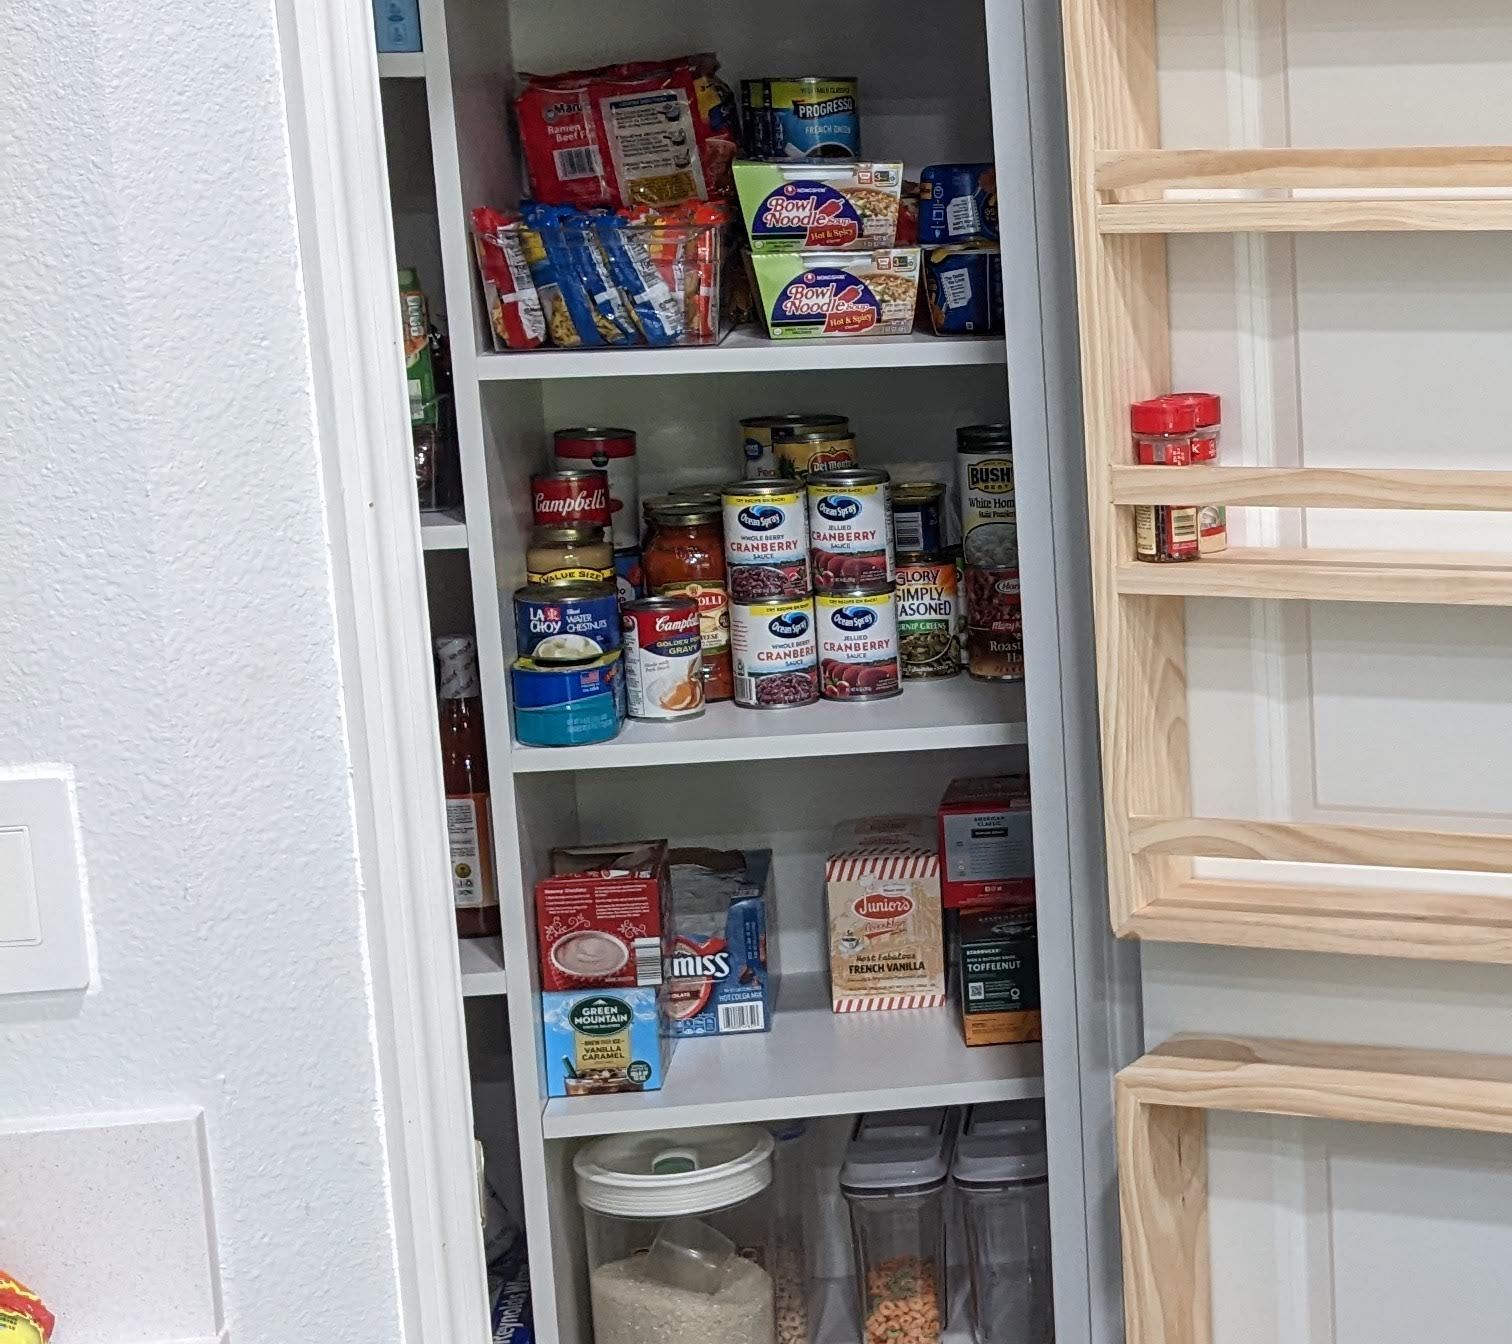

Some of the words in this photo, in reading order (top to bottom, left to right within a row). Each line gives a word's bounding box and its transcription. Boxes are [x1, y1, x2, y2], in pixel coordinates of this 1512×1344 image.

[799, 98, 853, 118] PROGRESSO
[547, 124, 581, 136] Ramen
[805, 125, 832, 135] FRENCH
[556, 132, 577, 144] Beef
[767, 196, 817, 213] Bowl
[763, 210, 828, 228] Noodle
[827, 218, 851, 227] Soup
[810, 231, 826, 241] Hot
[833, 227, 854, 239] Spicy
[787, 282, 836, 301] Bowl
[783, 298, 846, 316] Noodle
[846, 304, 870, 312] Soup
[830, 318, 844, 328] Hot
[852, 313, 873, 324] Spicy
[534, 489, 607, 516] Campbell's
[968, 497, 992, 509] White
[819, 502, 839, 517] Ocean
[837, 502, 857, 519] Spray
[740, 513, 761, 527] Ocean
[759, 513, 781, 529] Spray
[812, 529, 876, 542] CRANBERRY
[730, 540, 798, 553] CRANBERRY
[542, 571, 575, 584] VALUE
[578, 570, 603, 581] SIZE
[895, 569, 941, 586] GLORY
[529, 607, 545, 621] LA
[566, 613, 593, 623] WATER
[834, 614, 855, 627] Ocean
[853, 613, 872, 629] Spray
[529, 620, 562, 634] CHOY
[771, 622, 792, 634] Ocean
[791, 620, 808, 635] Spray
[656, 639, 688, 648] GOLDEN
[668, 644, 698, 655] GRAVY
[823, 639, 890, 652] CRANBERRY
[785, 659, 804, 667] SAUCE
[858, 893, 912, 915] Junior's
[673, 952, 730, 978] miss
[848, 963, 885, 975] FRENCH
[886, 960, 926, 973] VANILLA
[966, 960, 1022, 973] TOFFEENUT
[581, 1005, 619, 1016] GREEN
[574, 1013, 628, 1025] MOUNTAIN
[584, 1045, 622, 1054] VANILLA
[582, 1052, 625, 1062] CARAMEL
